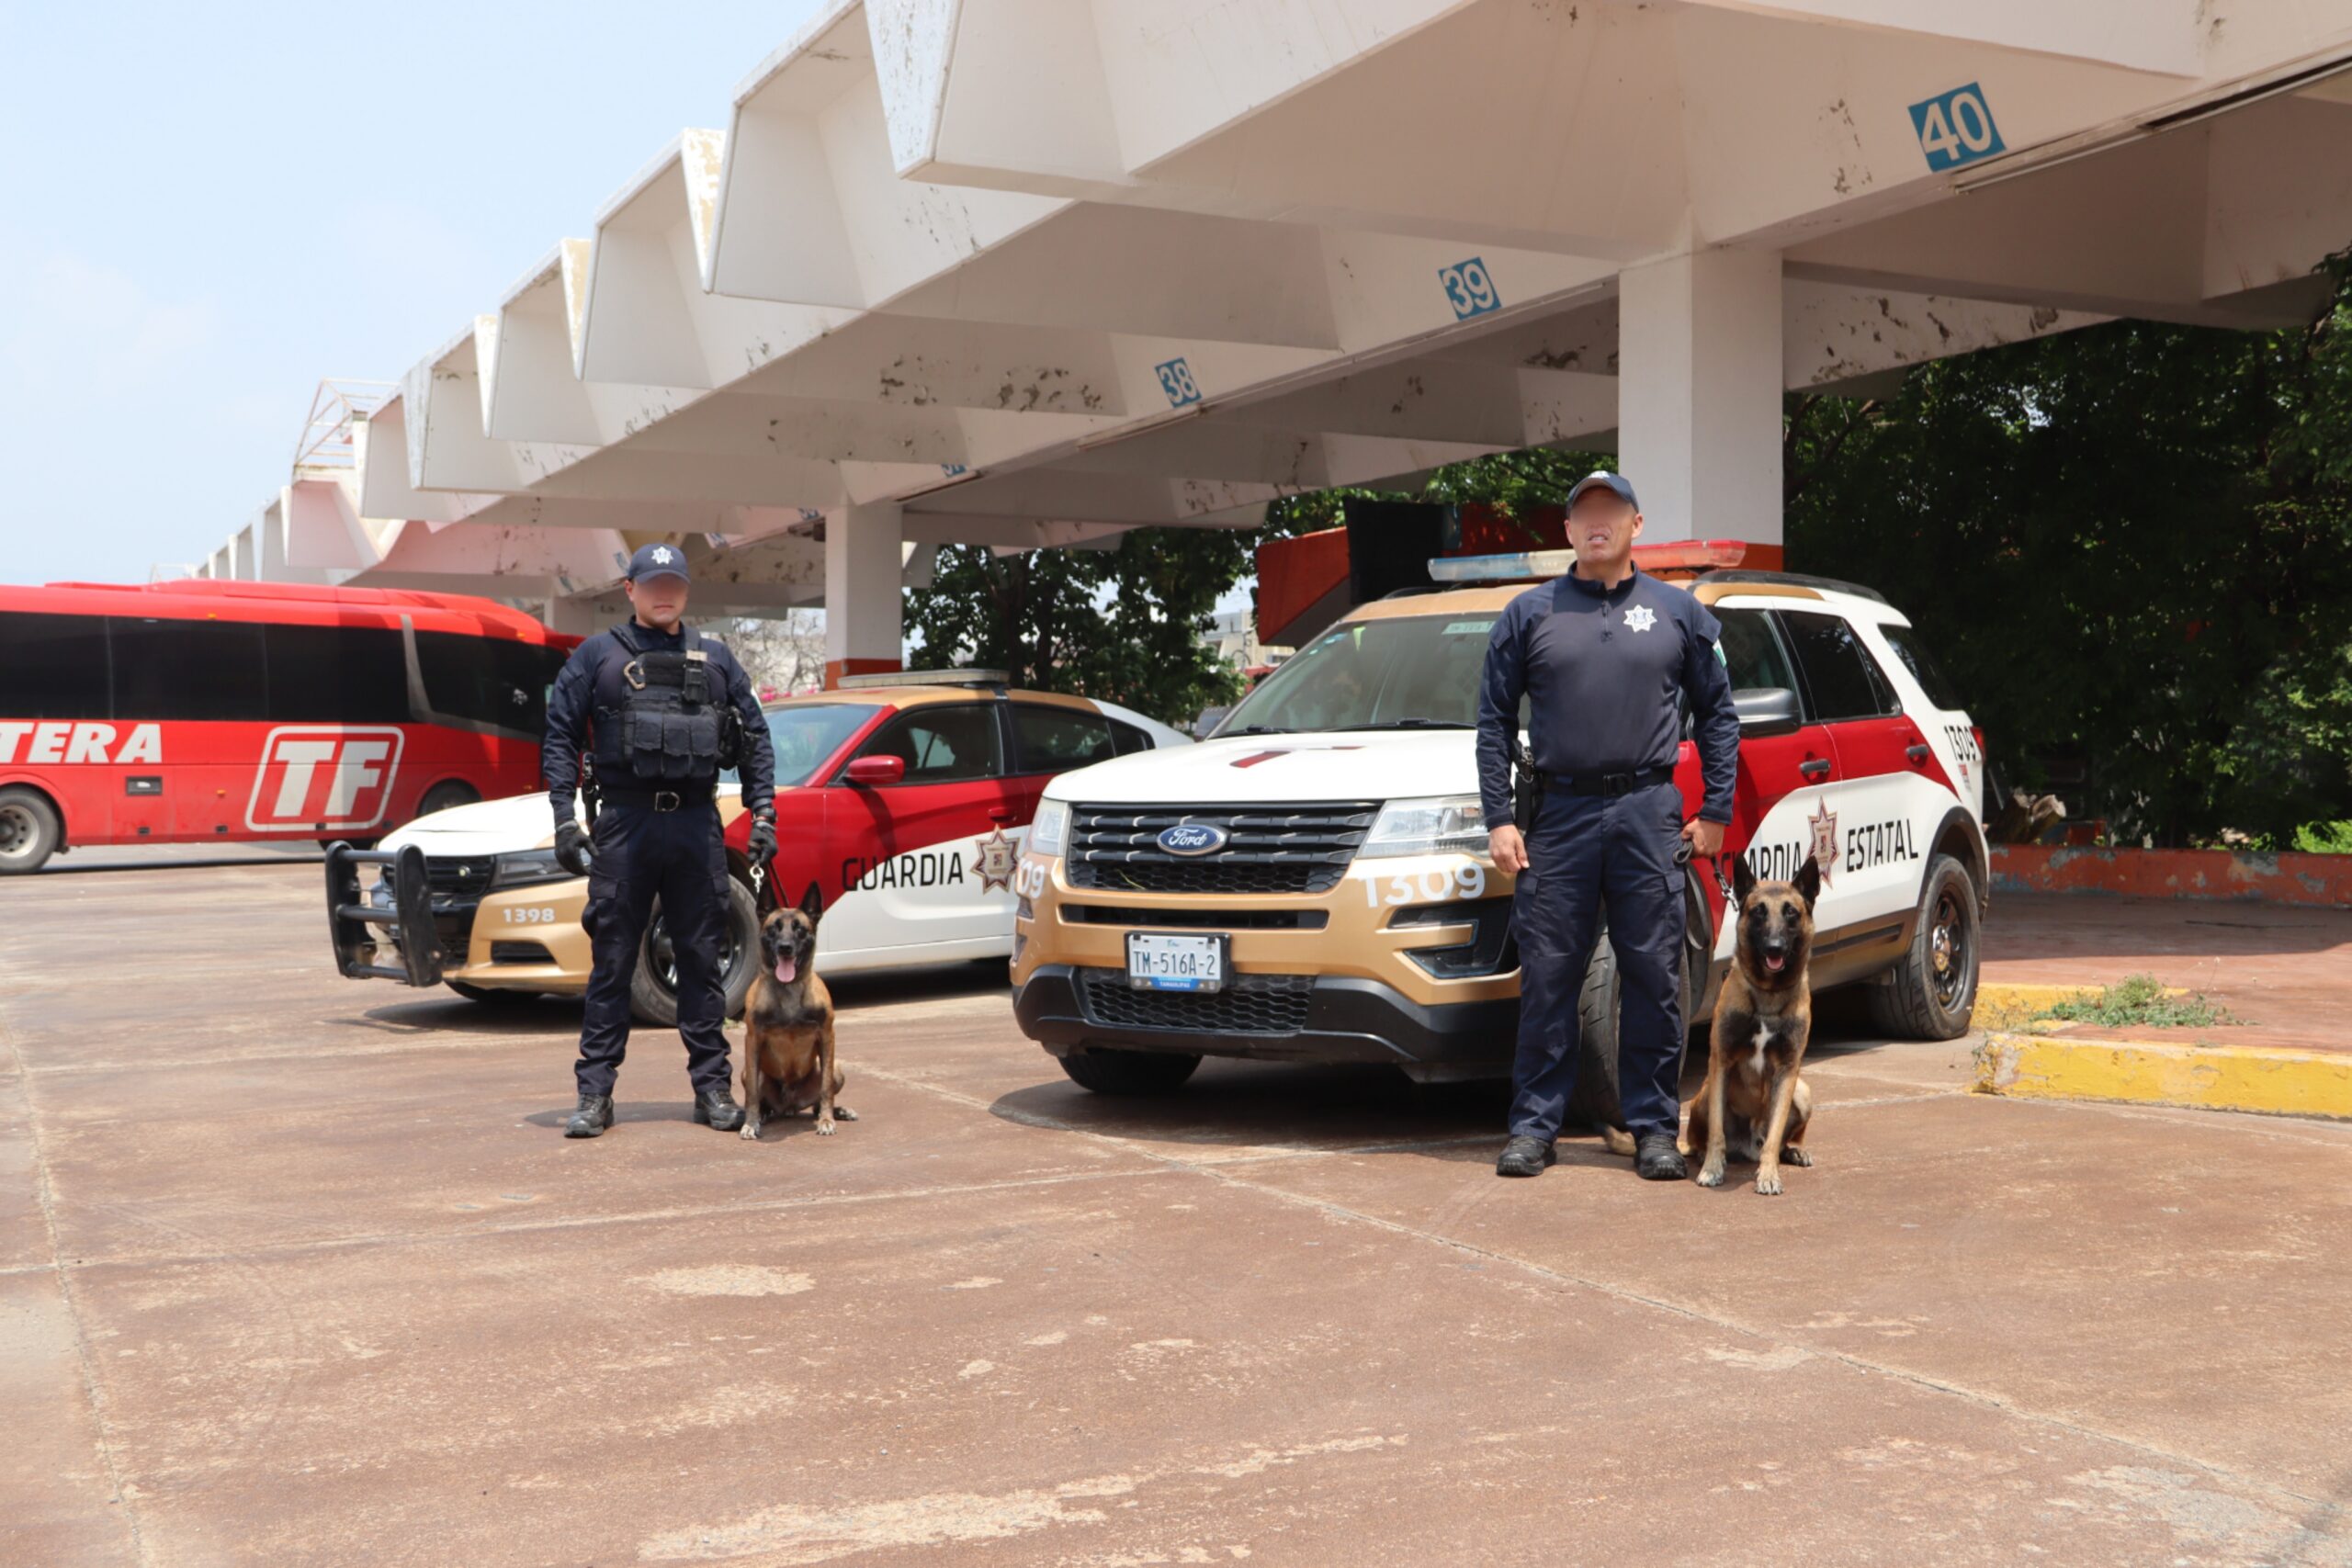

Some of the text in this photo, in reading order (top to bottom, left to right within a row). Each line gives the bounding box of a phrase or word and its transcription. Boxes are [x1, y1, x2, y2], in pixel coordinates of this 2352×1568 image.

[1921, 92, 1991, 161] 40
[1442, 263, 1493, 314] 39
[1159, 363, 1197, 404] 38
[1944, 725, 1977, 761] 1309
[272, 740, 390, 817] TF
[1169, 828, 1207, 846] Ford
[1846, 818, 1919, 873] ESTATAL
[842, 852, 964, 892] GUARDIA
[1017, 858, 1045, 898] 09
[1720, 840, 1803, 882] GARDIA
[1358, 860, 1486, 908] 1309
[503, 907, 555, 923] 1398
[1133, 951, 1216, 976] TM-516A-2
